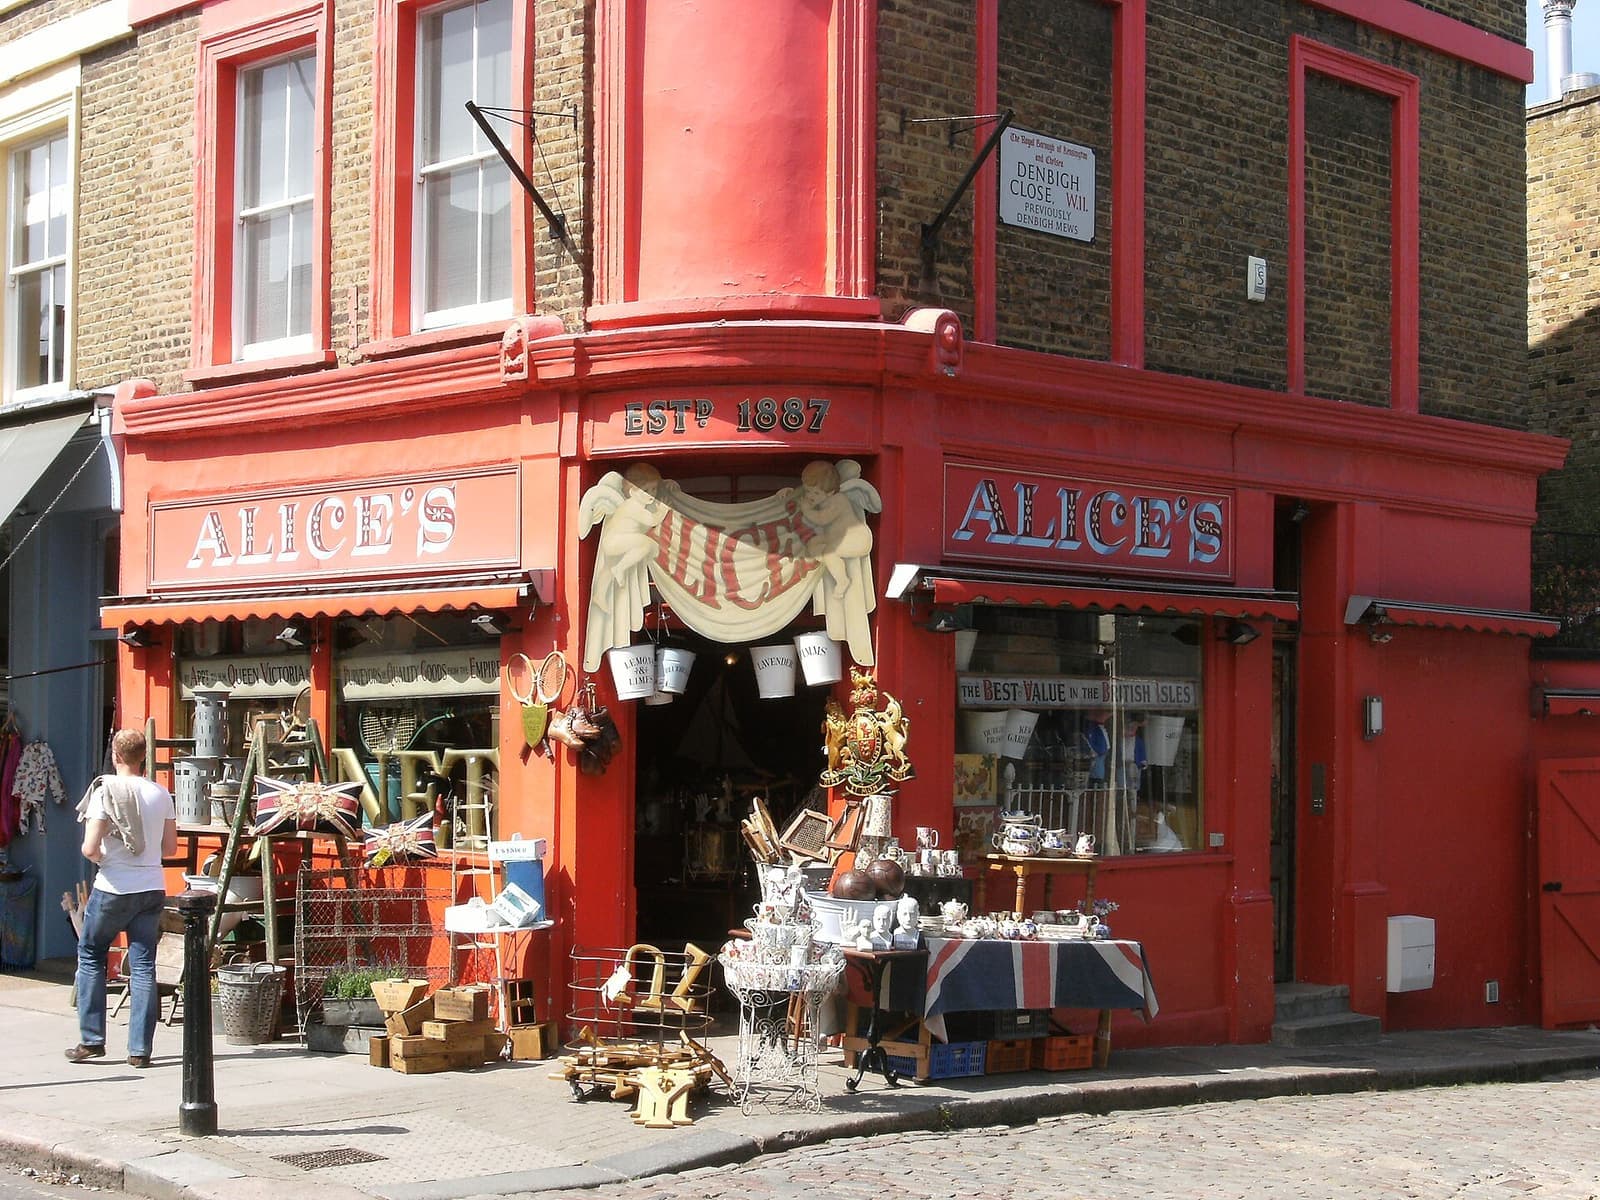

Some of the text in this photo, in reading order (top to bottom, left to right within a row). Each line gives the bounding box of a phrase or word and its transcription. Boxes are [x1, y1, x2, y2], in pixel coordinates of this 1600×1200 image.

[1010, 133, 1020, 142] The
[1017, 162, 1079, 191] DENBIGH
[1017, 213, 1079, 234] DENBIGH MEWS
[1025, 202, 1071, 221] PREVIOUSLY
[736, 397, 831, 433] 1887
[186, 481, 457, 569] ALICE'S
[952, 479, 1223, 564] ALICE'S
[227, 664, 260, 688] QUEEN
[260, 662, 306, 684] VICTORIA
[387, 662, 419, 687] QUALITY
[421, 659, 447, 681] GOODS
[757, 656, 793, 670] LAVENDER
[961, 685, 980, 698] THE
[983, 680, 1018, 701] BEST
[1023, 680, 1066, 701] VALUE
[1070, 687, 1078, 699] IN
[1082, 687, 1099, 699] THE
[1156, 682, 1190, 704] ISLES
